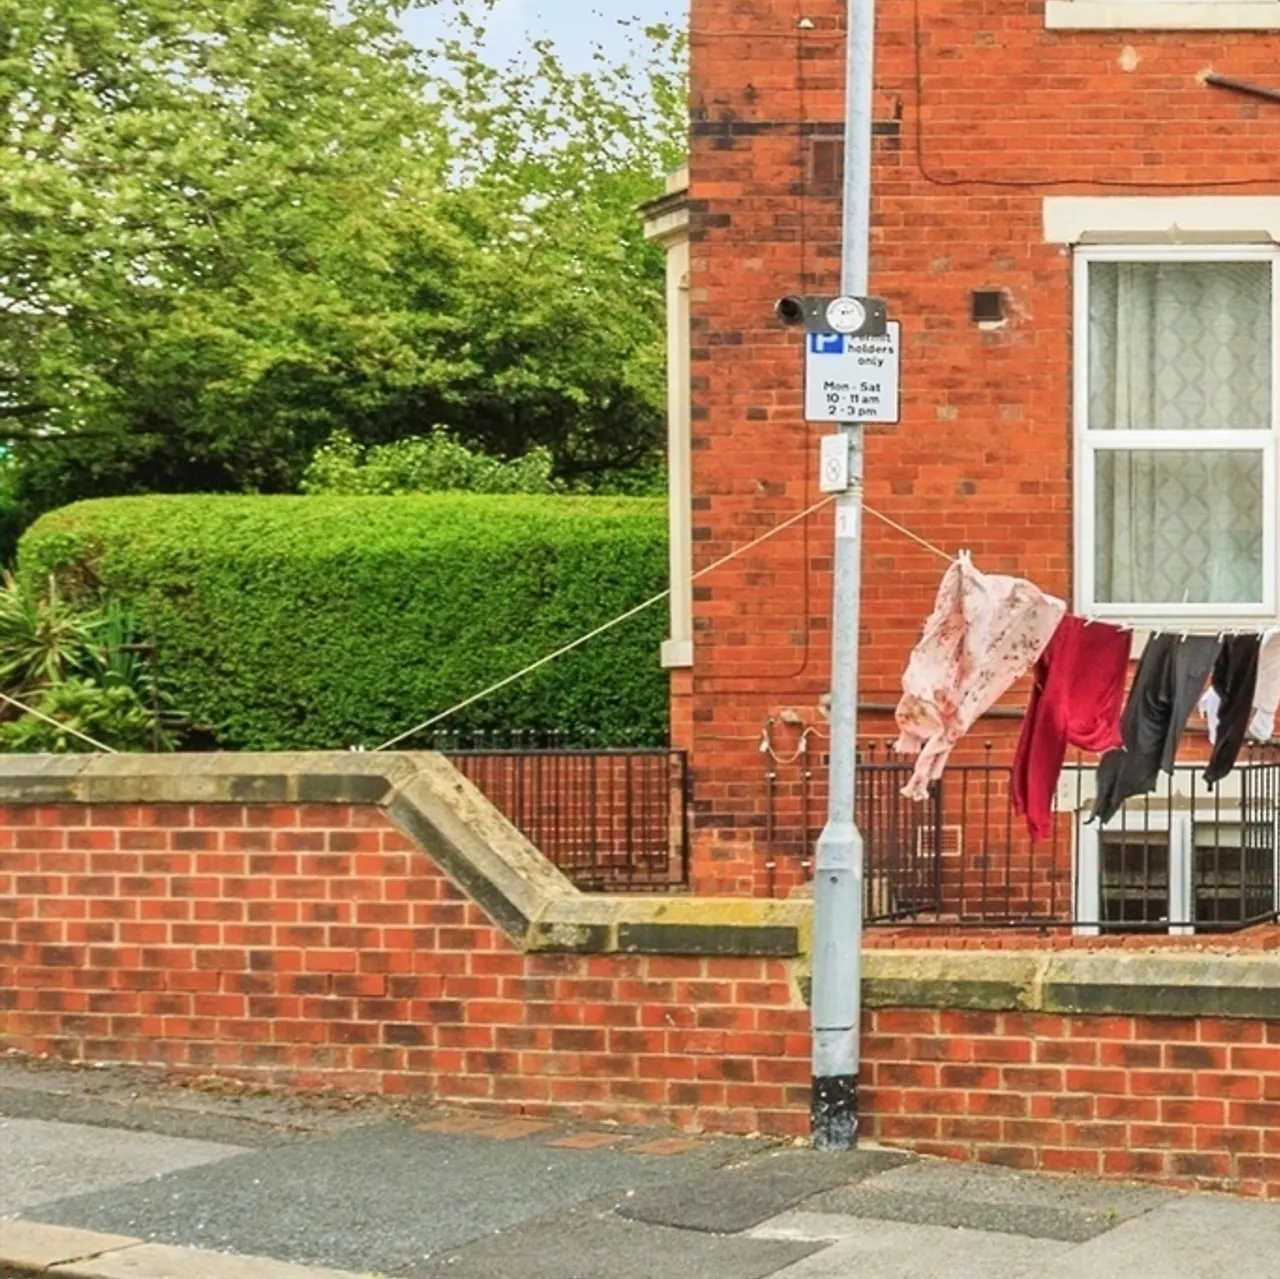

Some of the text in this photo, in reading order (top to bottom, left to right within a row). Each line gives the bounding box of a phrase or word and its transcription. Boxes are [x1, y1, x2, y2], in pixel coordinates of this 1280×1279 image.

[848, 344, 894, 354] holders
[857, 357, 884, 367] only
[823, 381, 849, 391] Mon
[860, 381, 881, 392] Sat
[826, 393, 840, 403] 10
[850, 394, 859, 403] 11
[862, 396, 880, 404] am
[828, 405, 837, 415] 2
[847, 405, 856, 416] 3
[858, 408, 877, 417] pm
